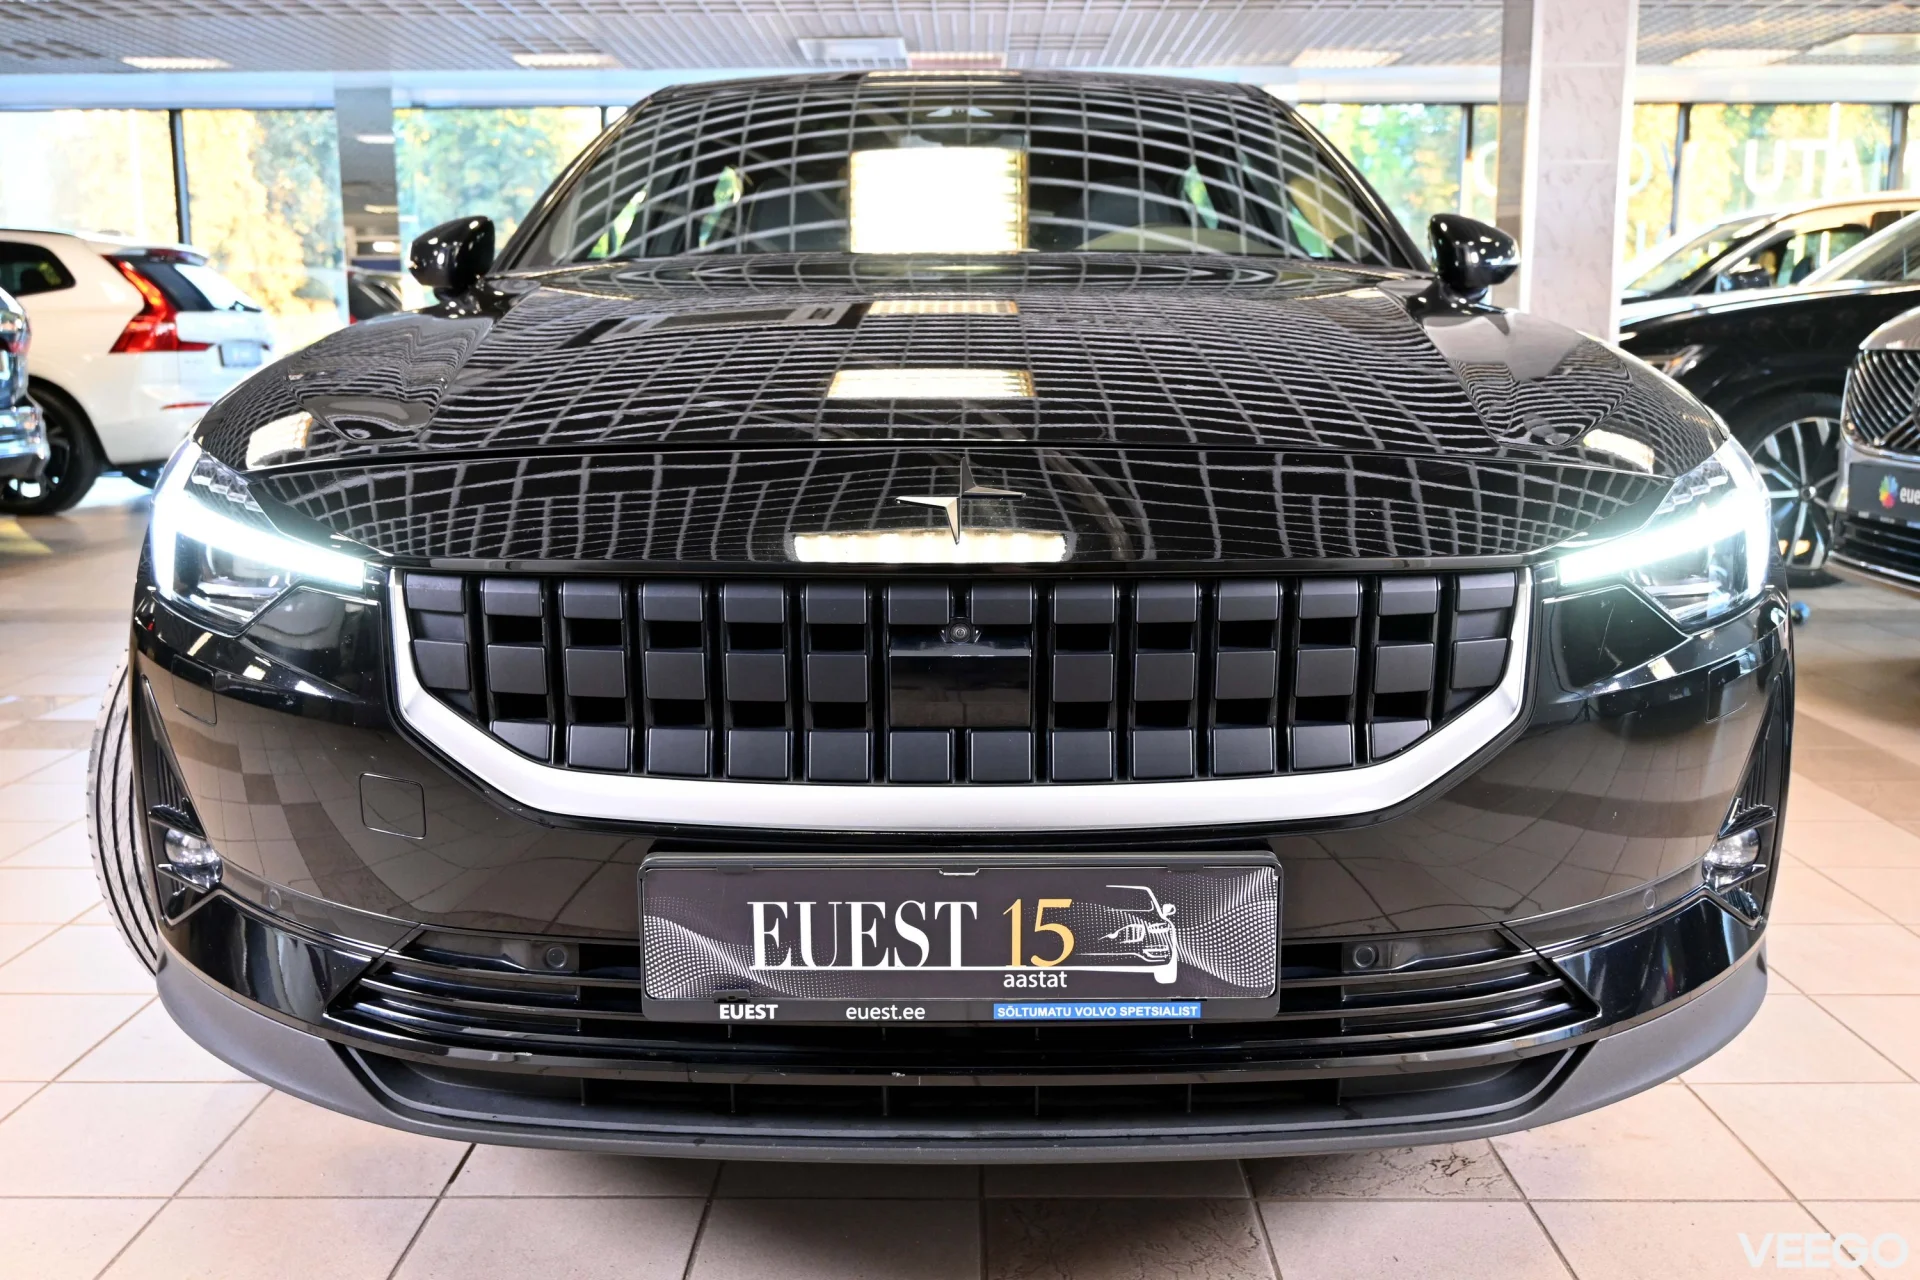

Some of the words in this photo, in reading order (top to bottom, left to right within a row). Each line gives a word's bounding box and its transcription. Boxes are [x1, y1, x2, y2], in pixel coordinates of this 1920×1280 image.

[747, 900, 978, 968] EUEST
[1002, 898, 1075, 968] 15
[1003, 971, 1068, 988] aastat
[719, 1004, 778, 1019] EUEST
[846, 1004, 925, 1019] euest.ee
[997, 1005, 1072, 1017] SÕLTUMATU
[1074, 1006, 1117, 1017] VOLVO
[1119, 1006, 1198, 1017] SPETSIALIST
